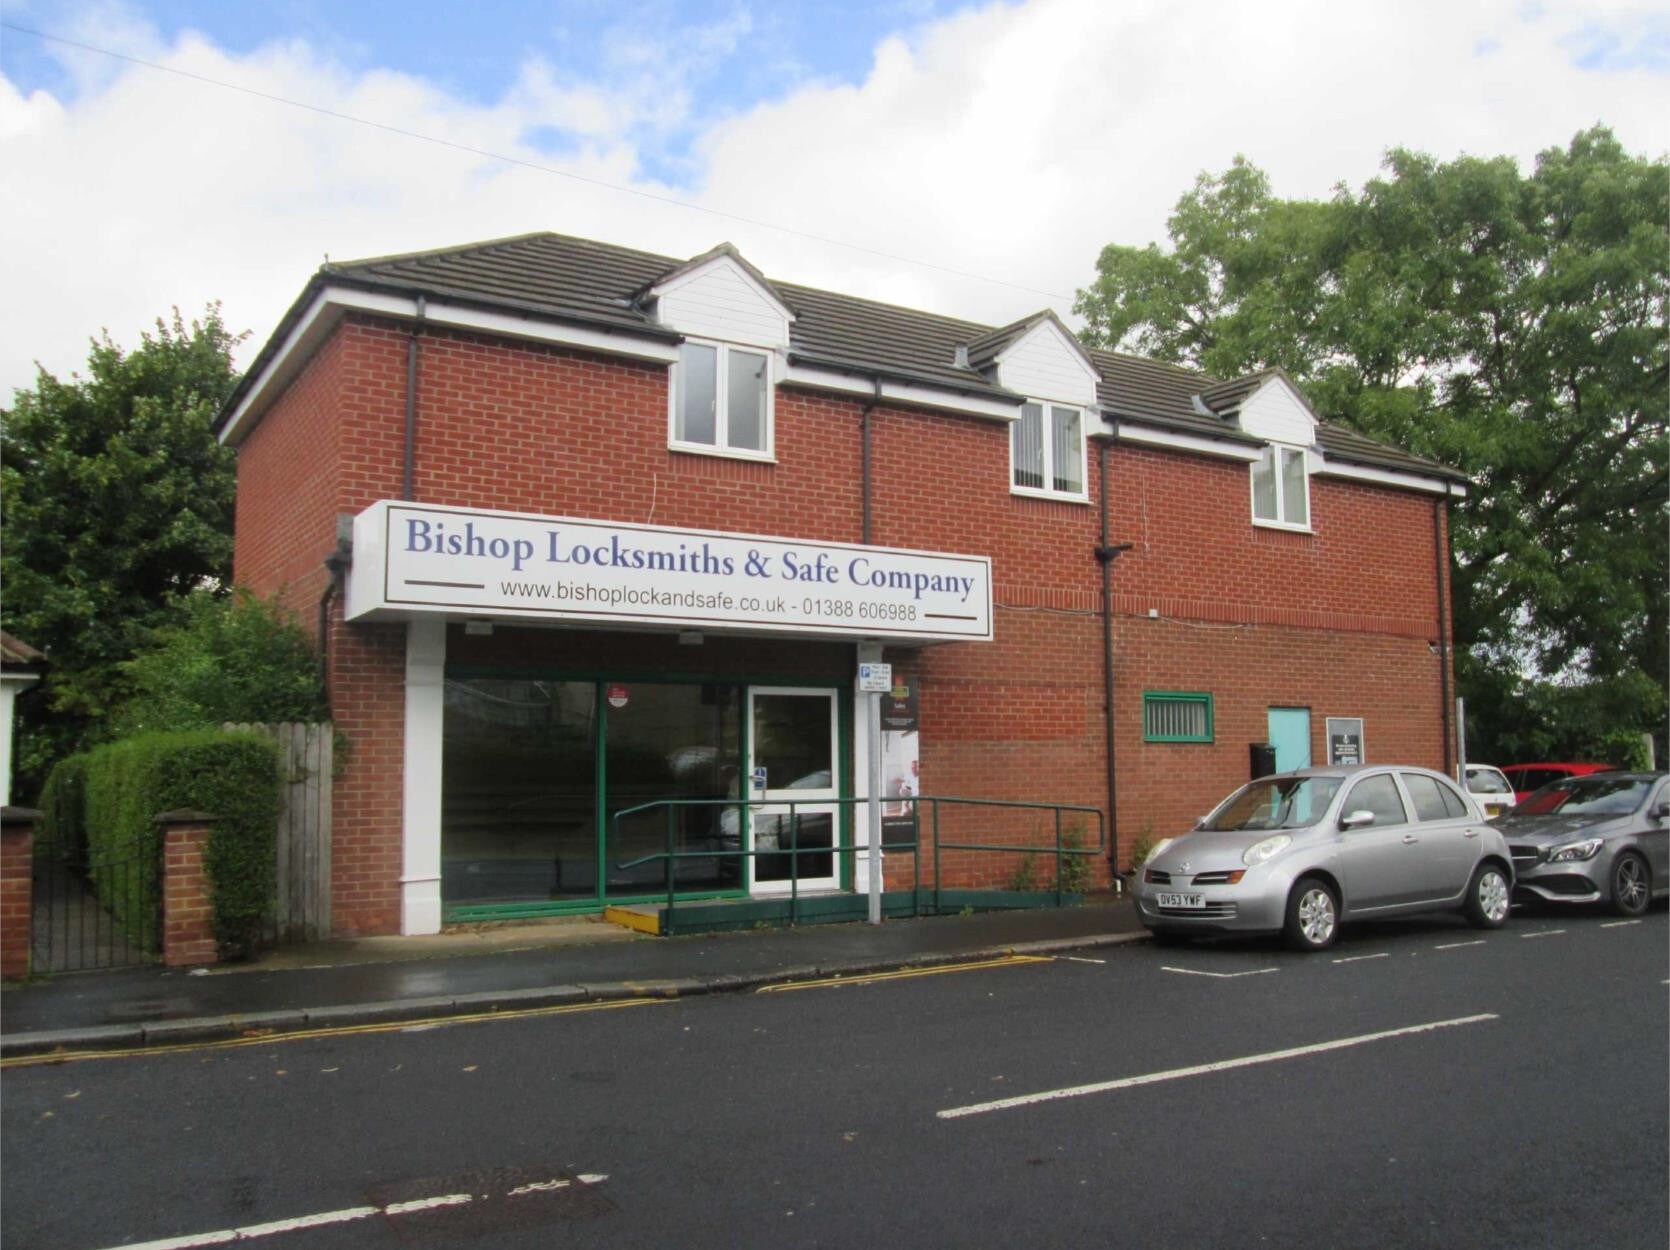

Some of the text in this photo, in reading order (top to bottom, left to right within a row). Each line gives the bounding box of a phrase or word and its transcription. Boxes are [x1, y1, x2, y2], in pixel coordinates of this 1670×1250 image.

[405, 518, 975, 602] Bishop Locksmiths & Safe Company
[500, 580, 785, 612] www.bishoplockandsafe.co.uk
[802, 597, 854, 617] 01388
[858, 603, 917, 621] 606988
